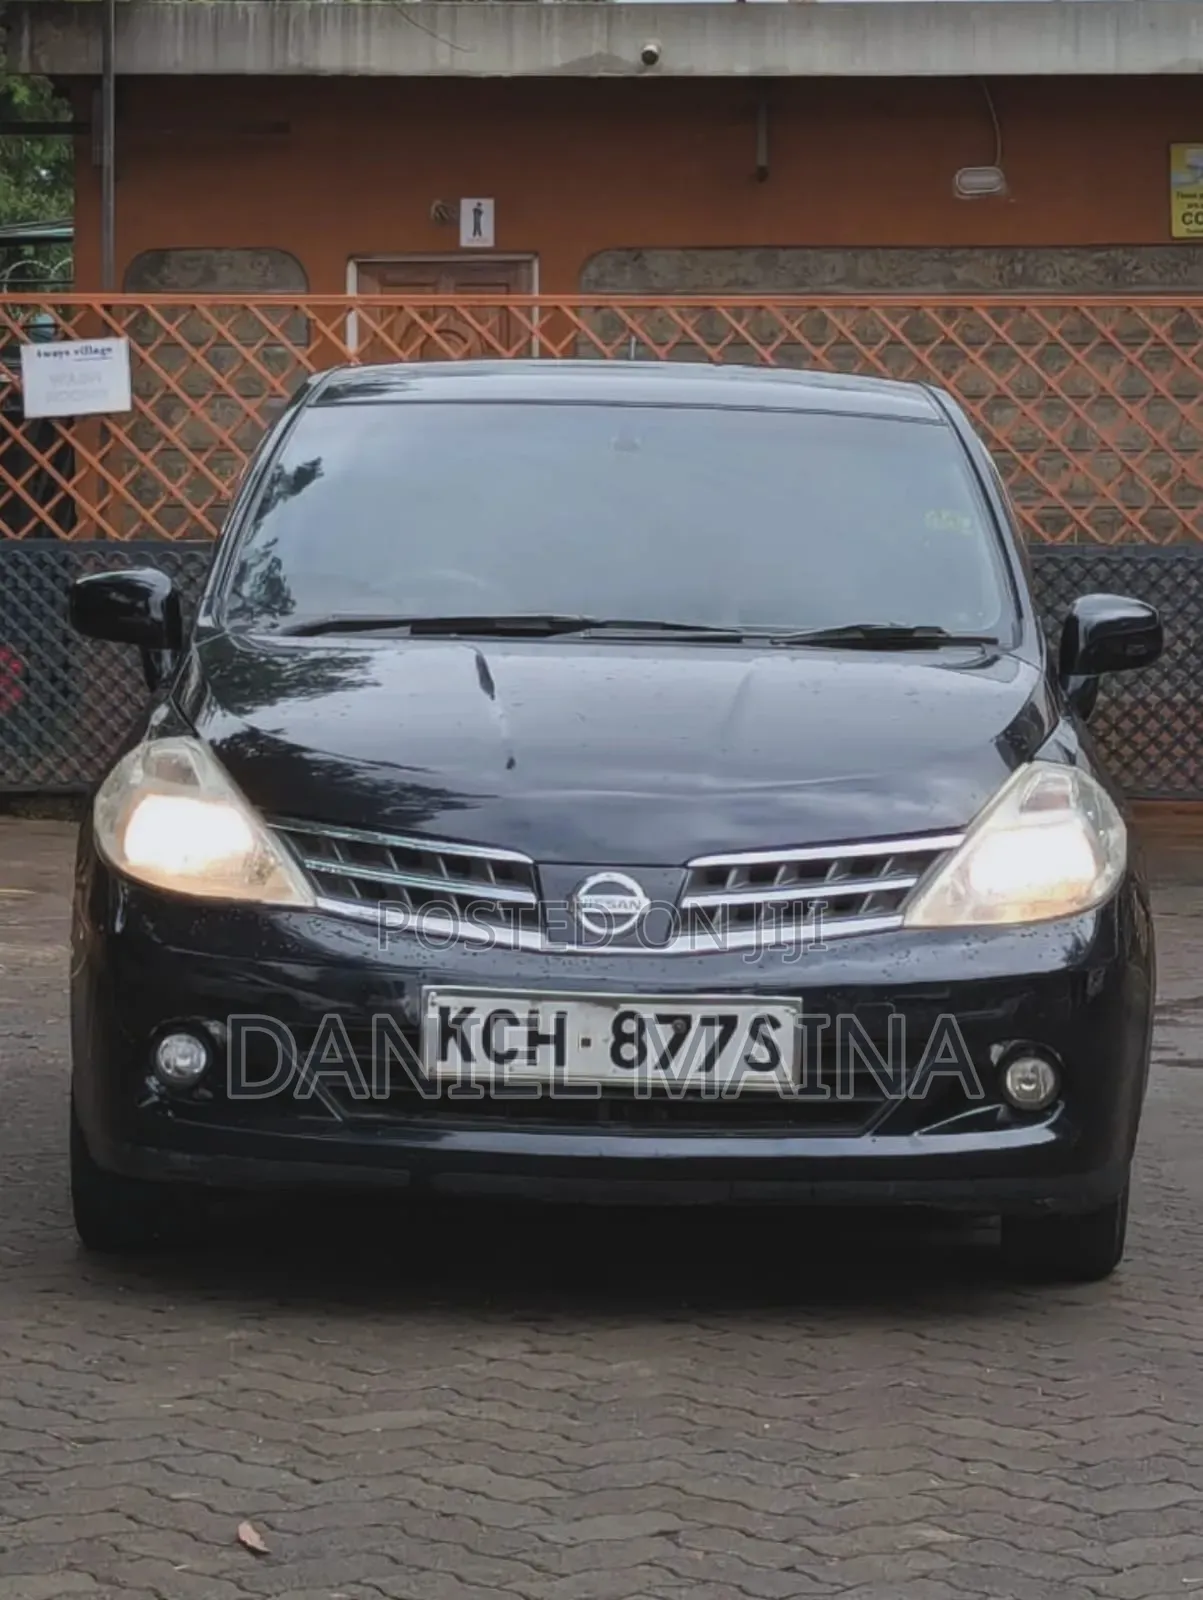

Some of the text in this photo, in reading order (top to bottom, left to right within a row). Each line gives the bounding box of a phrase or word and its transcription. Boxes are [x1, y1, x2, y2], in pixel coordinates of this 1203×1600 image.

[73, 345, 113, 357] village
[437, 1005, 782, 1073] KCH 877S
